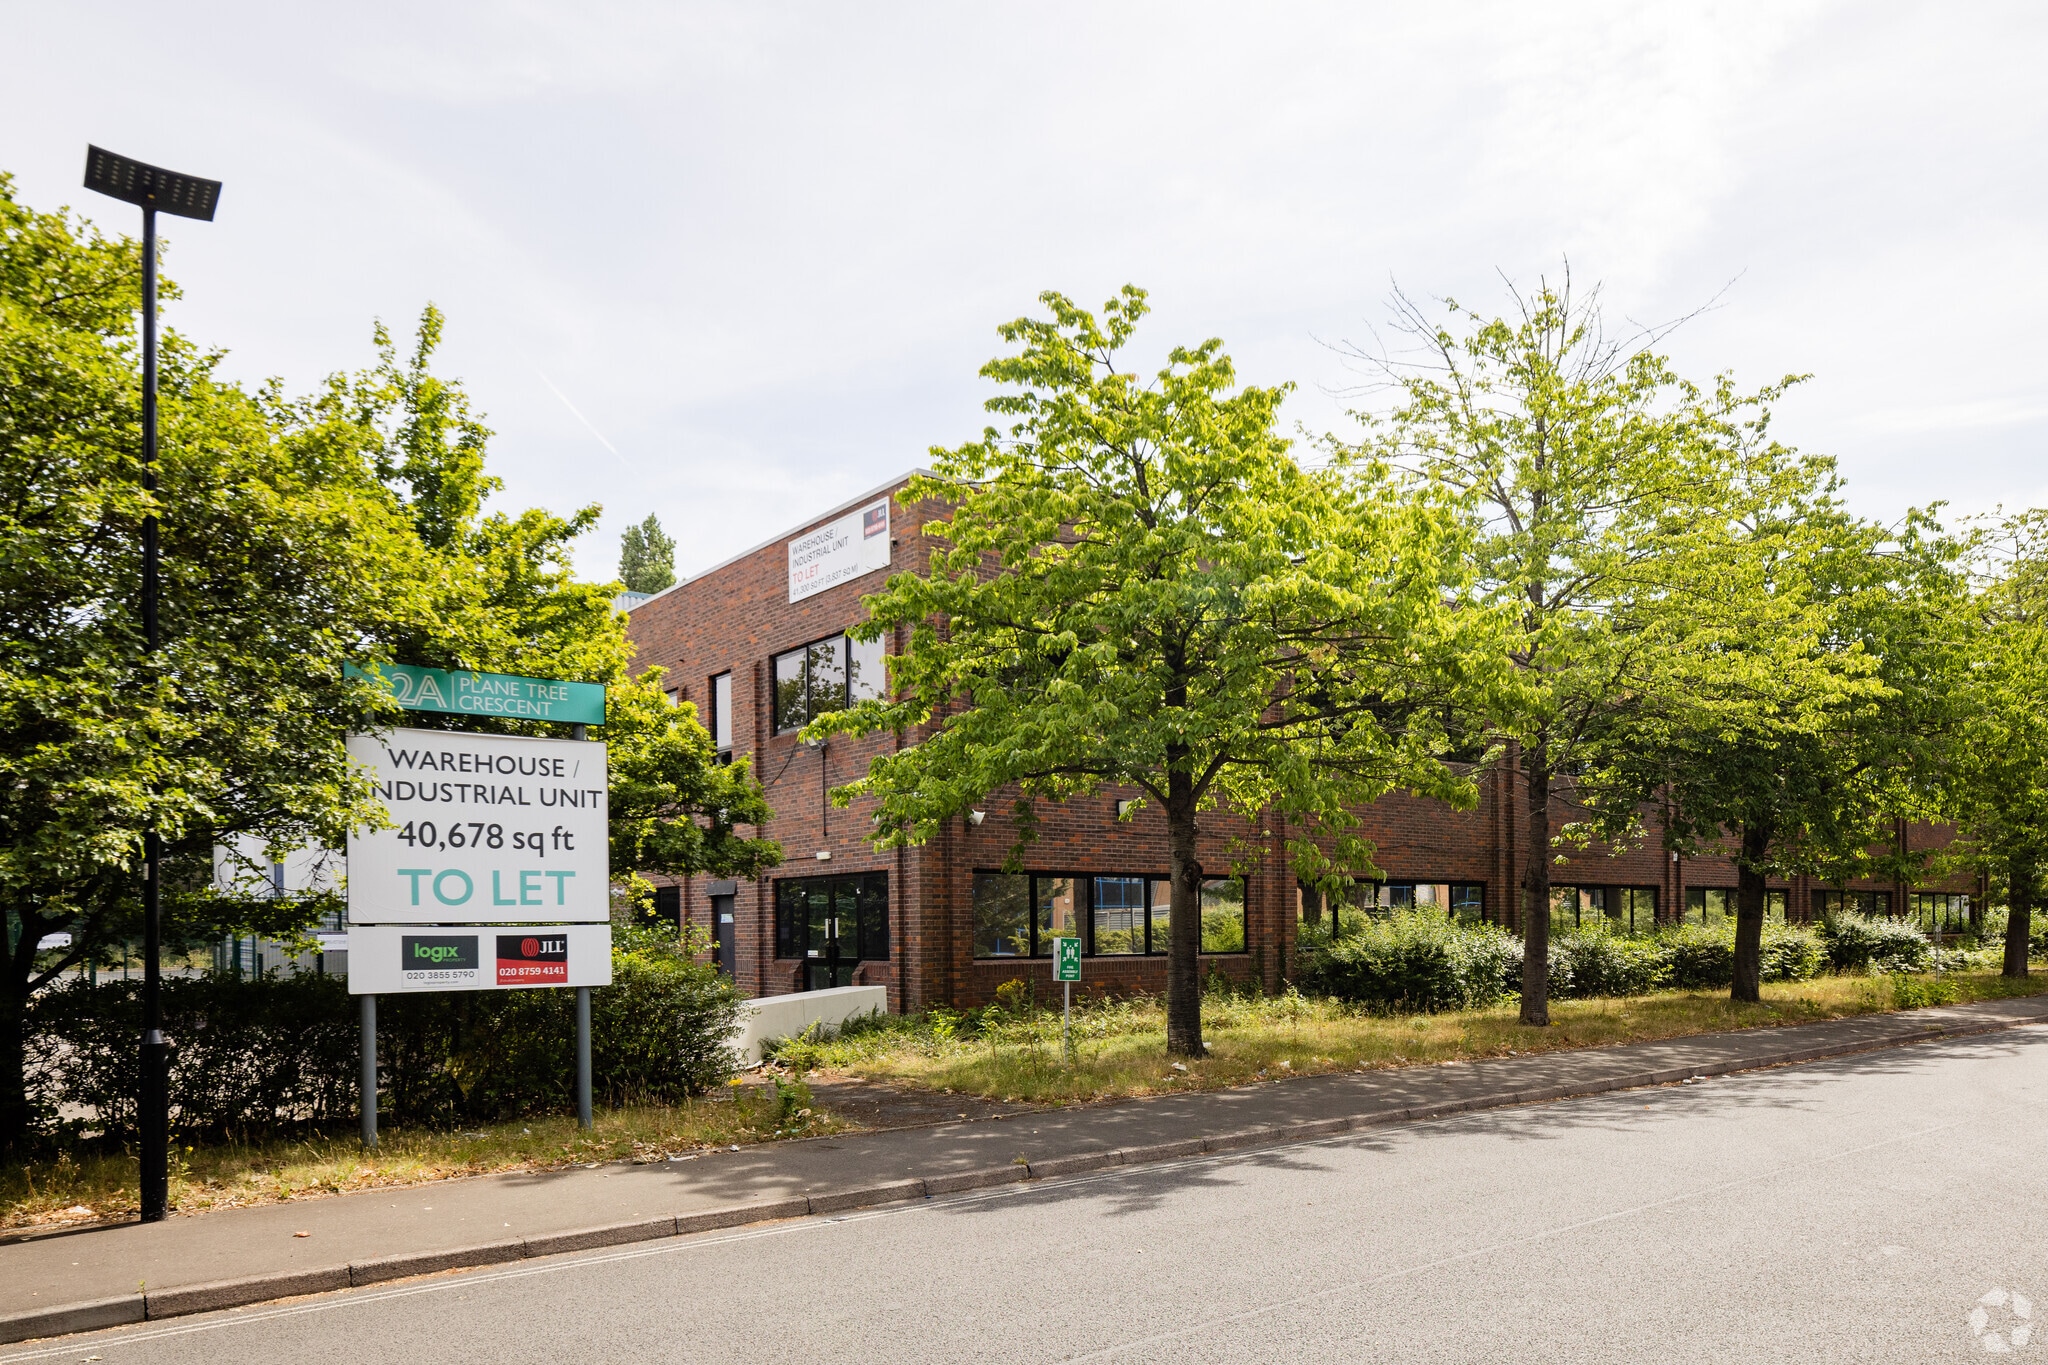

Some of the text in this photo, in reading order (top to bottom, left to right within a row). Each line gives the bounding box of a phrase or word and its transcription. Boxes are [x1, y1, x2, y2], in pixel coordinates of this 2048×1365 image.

[792, 529, 834, 555] WAREHOUSE
[792, 536, 848, 569] INDUSTRIAL UNIT
[792, 564, 819, 584] TO LET
[811, 580, 818, 590] SQ
[843, 567, 850, 576] SQ
[459, 677, 568, 701] PLANE TREE
[459, 695, 553, 716] CRESCENT
[388, 748, 565, 778] WAREHOUSE
[363, 780, 602, 808] NDUSTRIAL UNIT
[397, 820, 574, 858] 40,678 sq ft
[397, 869, 576, 906] TO LET
[414, 942, 458, 962] logix
[540, 940, 564, 954] JLL
[500, 966, 564, 976] 020 8759 4141
